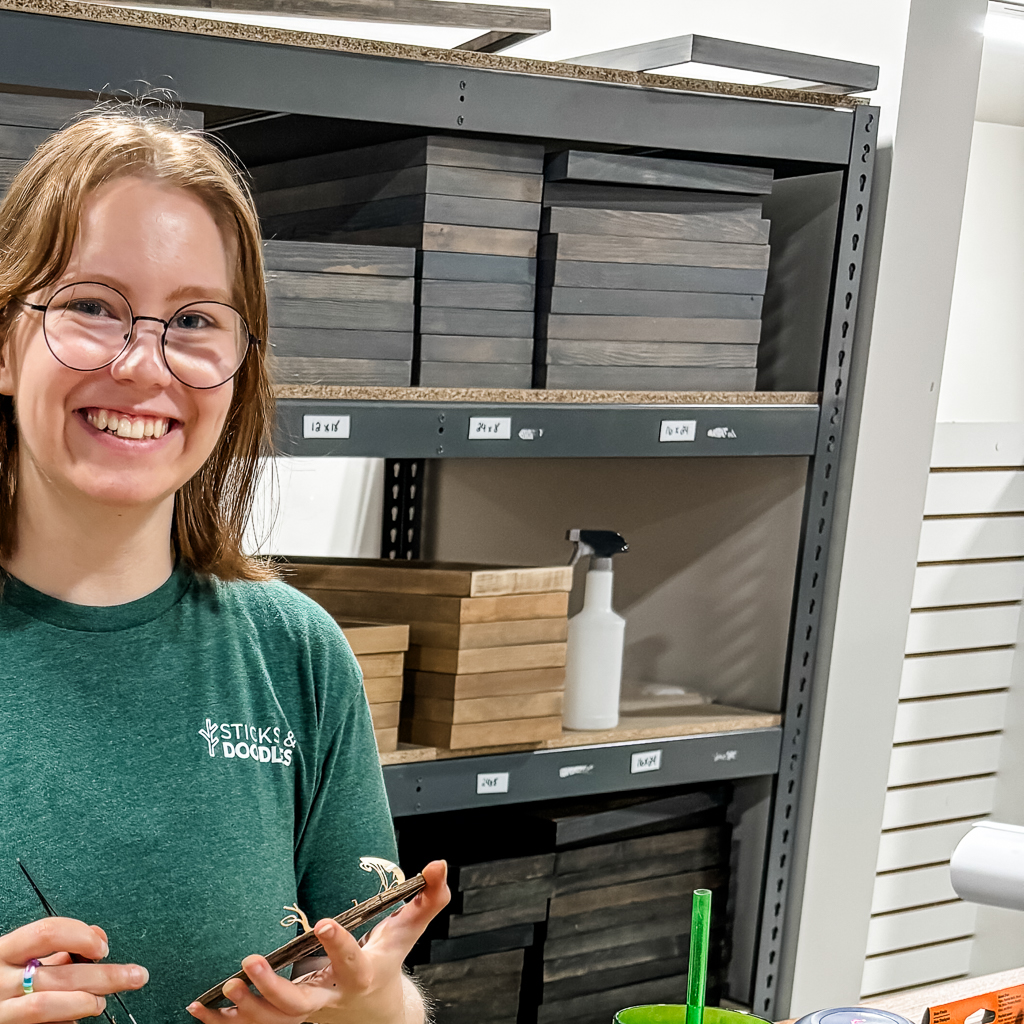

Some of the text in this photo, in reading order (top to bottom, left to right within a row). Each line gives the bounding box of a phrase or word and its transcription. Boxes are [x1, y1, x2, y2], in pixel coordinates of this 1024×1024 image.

[220, 723, 296, 748] STICKS &
[222, 741, 292, 767] DOODLES
